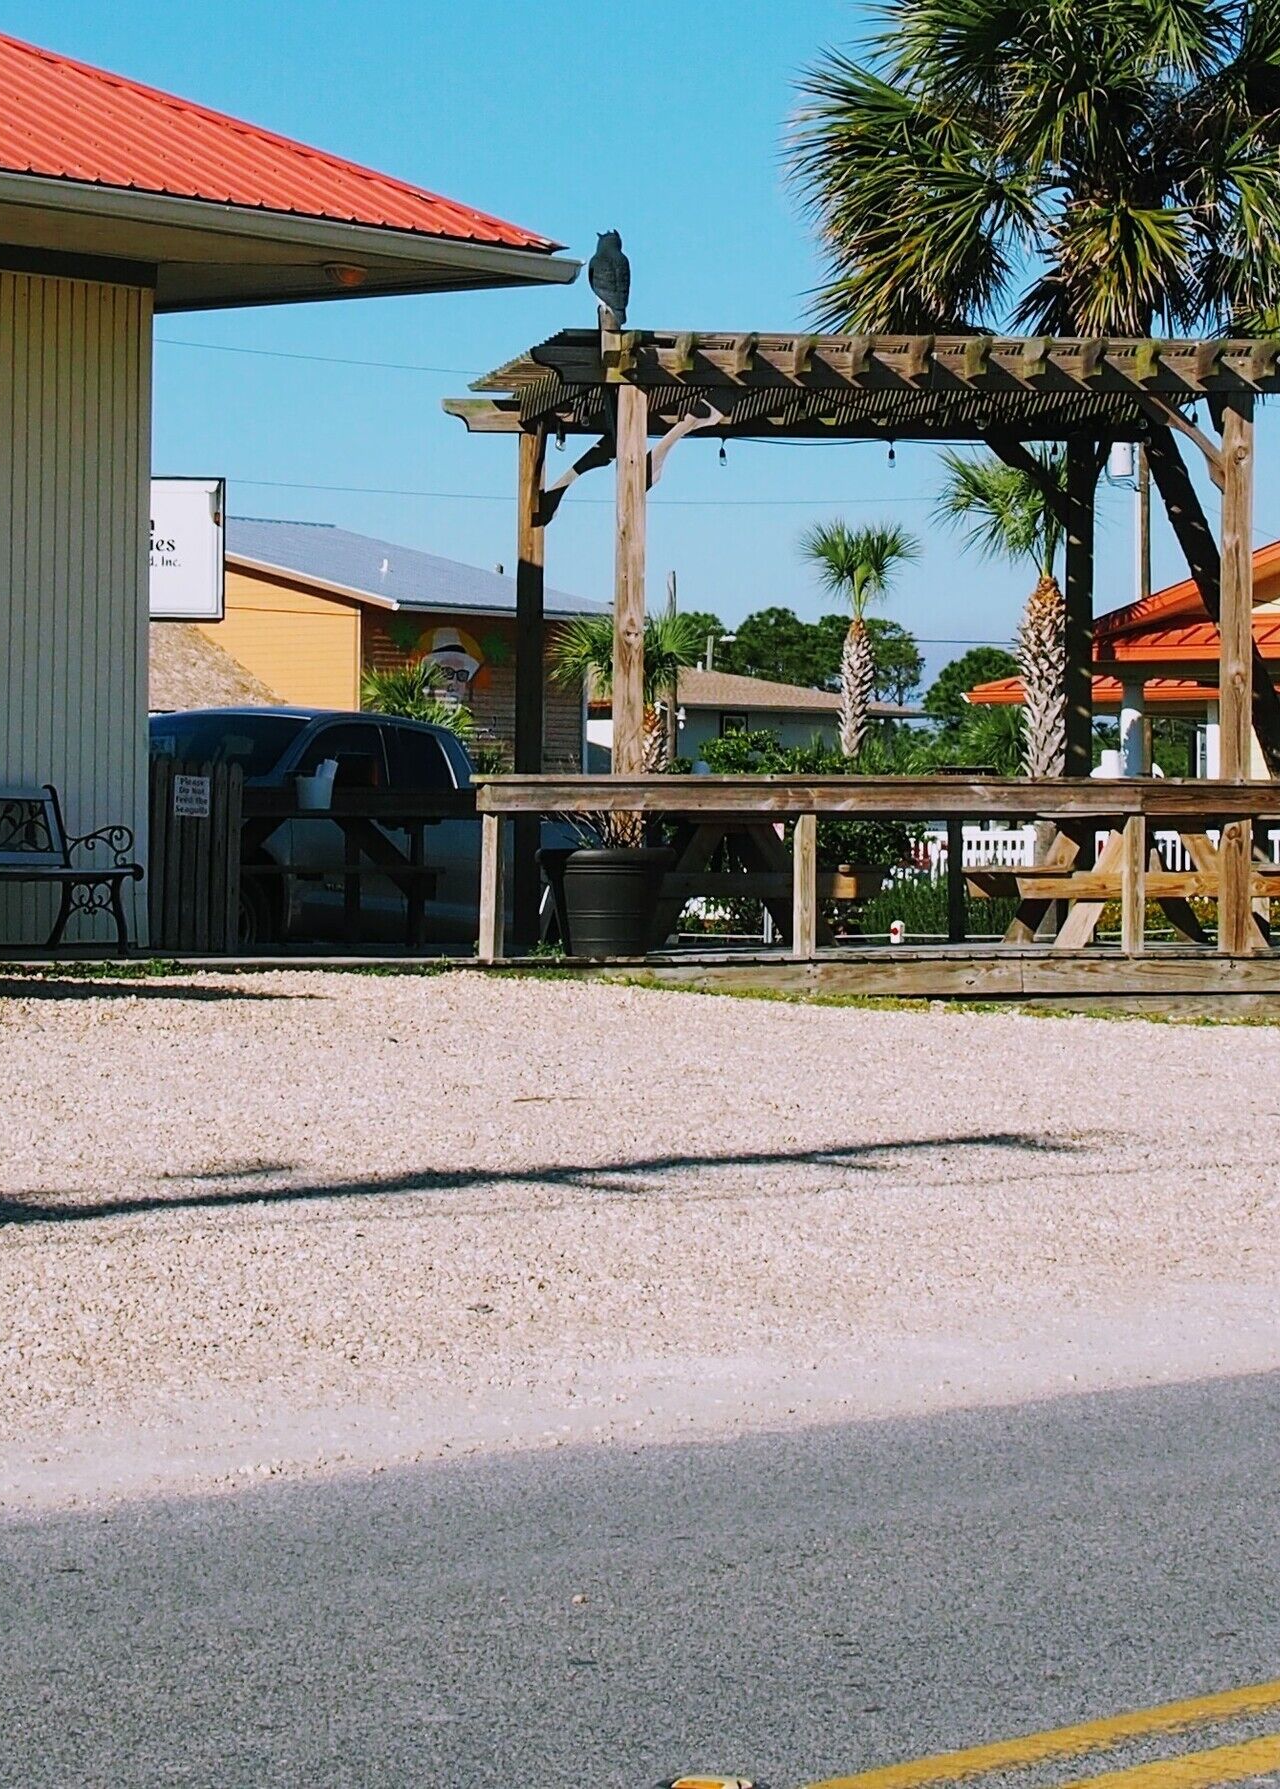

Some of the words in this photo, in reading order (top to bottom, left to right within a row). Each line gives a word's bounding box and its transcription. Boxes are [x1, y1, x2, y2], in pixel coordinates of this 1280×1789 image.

[161, 556, 181, 567] Inc.
[180, 777, 204, 786] Please
[179, 786, 190, 794] Do
